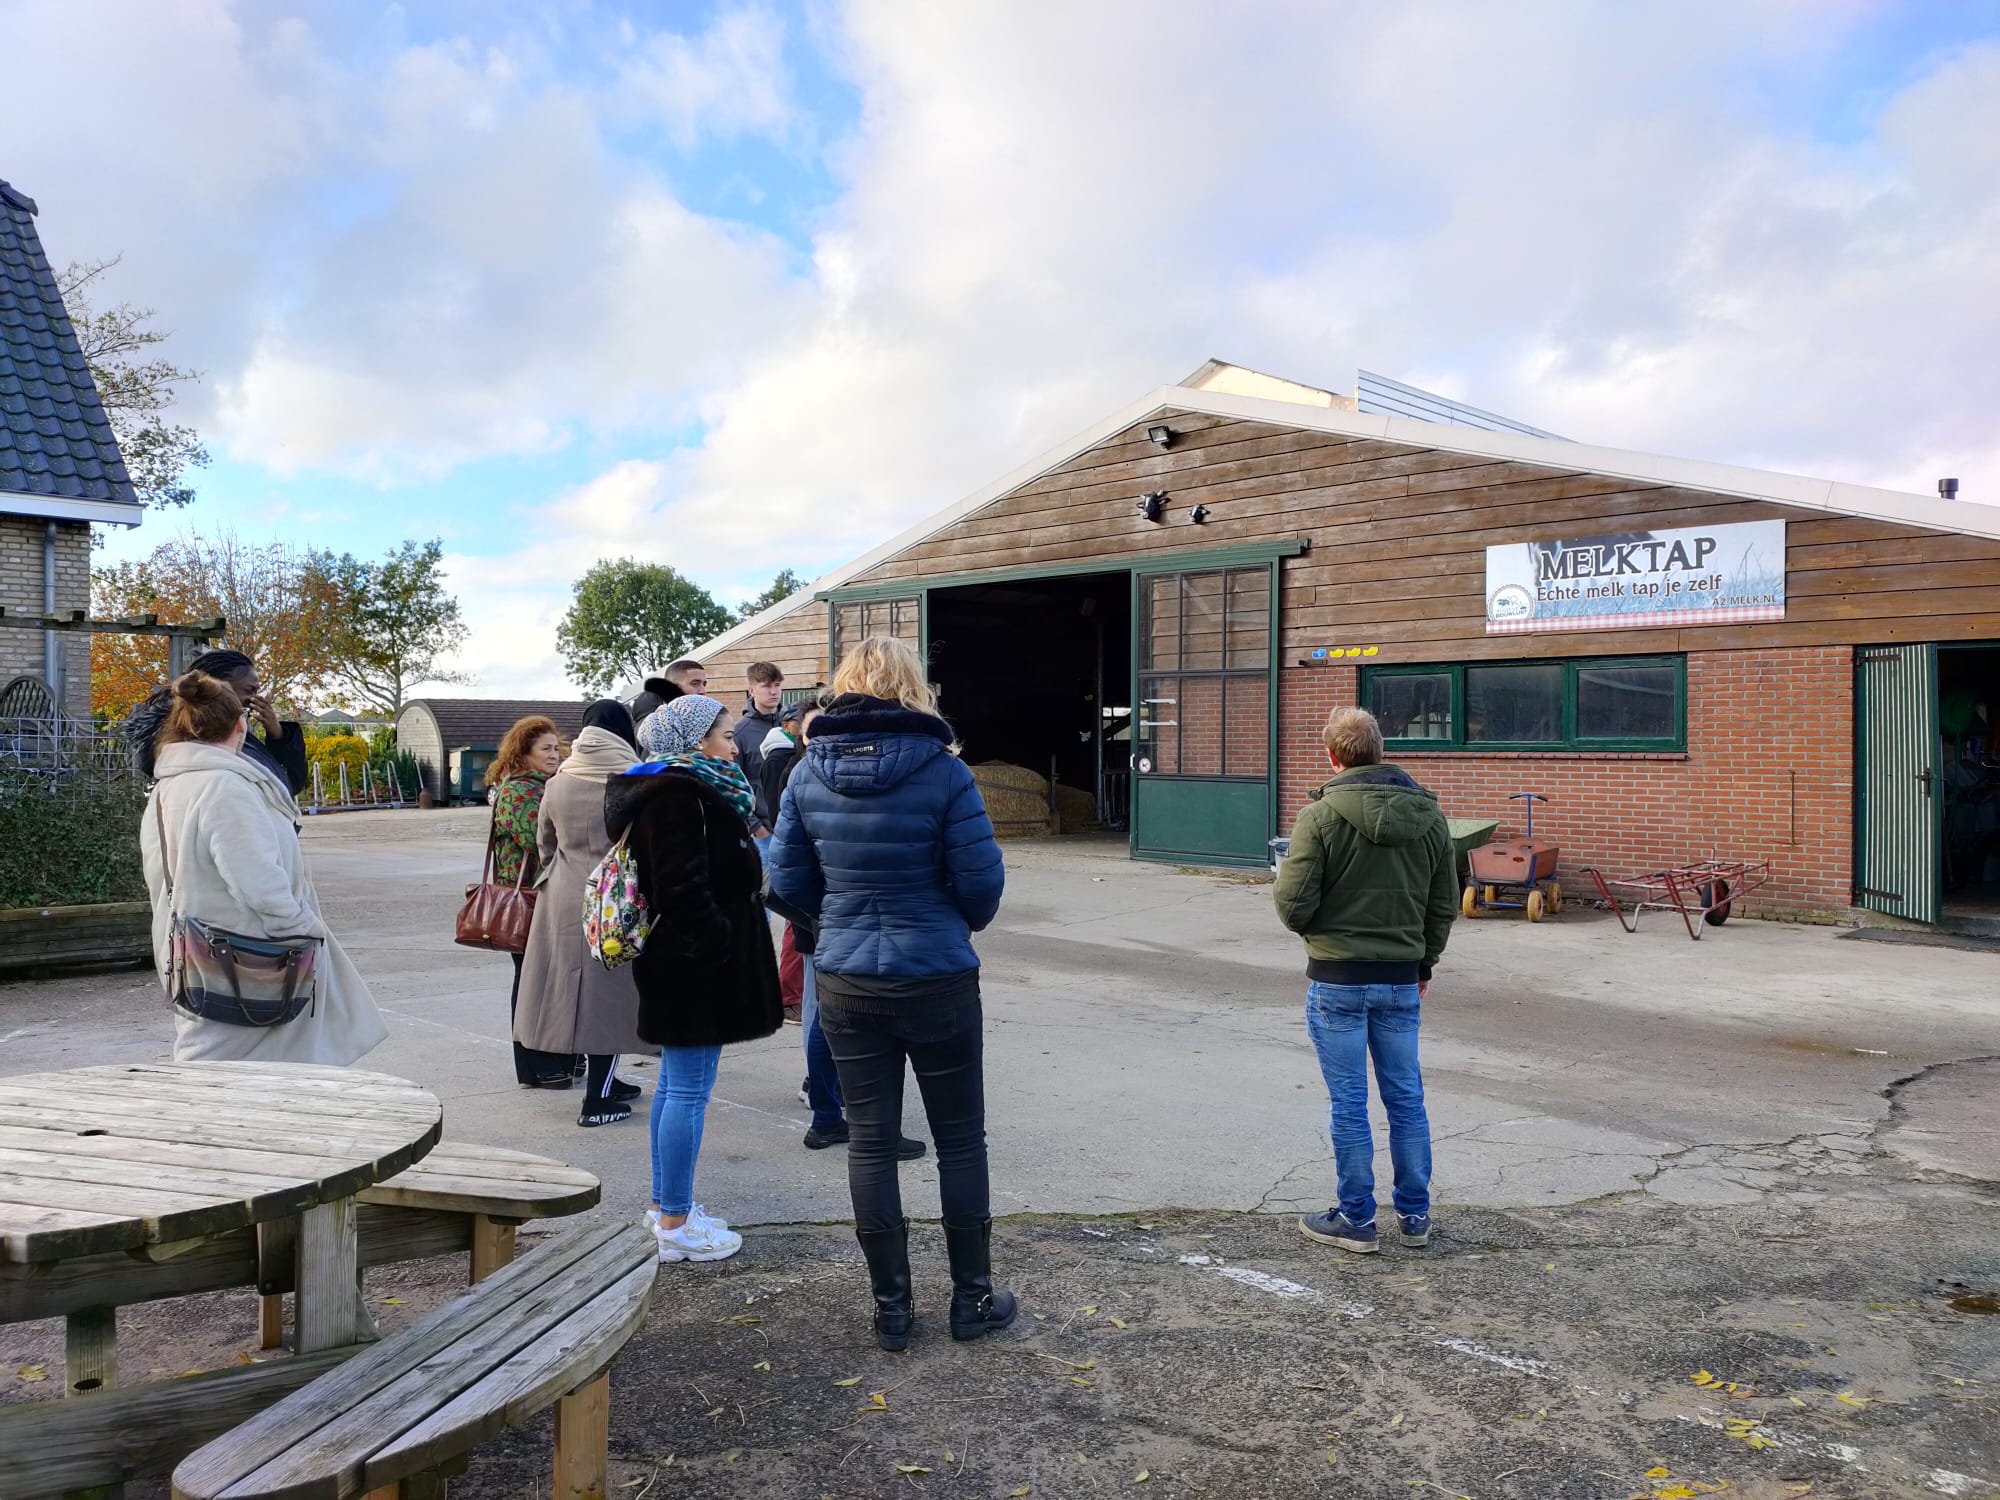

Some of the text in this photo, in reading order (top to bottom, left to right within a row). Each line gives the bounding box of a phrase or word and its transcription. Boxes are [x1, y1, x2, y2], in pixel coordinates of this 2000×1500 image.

[1540, 537, 1717, 581] MELKTAP
[1537, 573, 1722, 602] Echte melk tap je zelf
